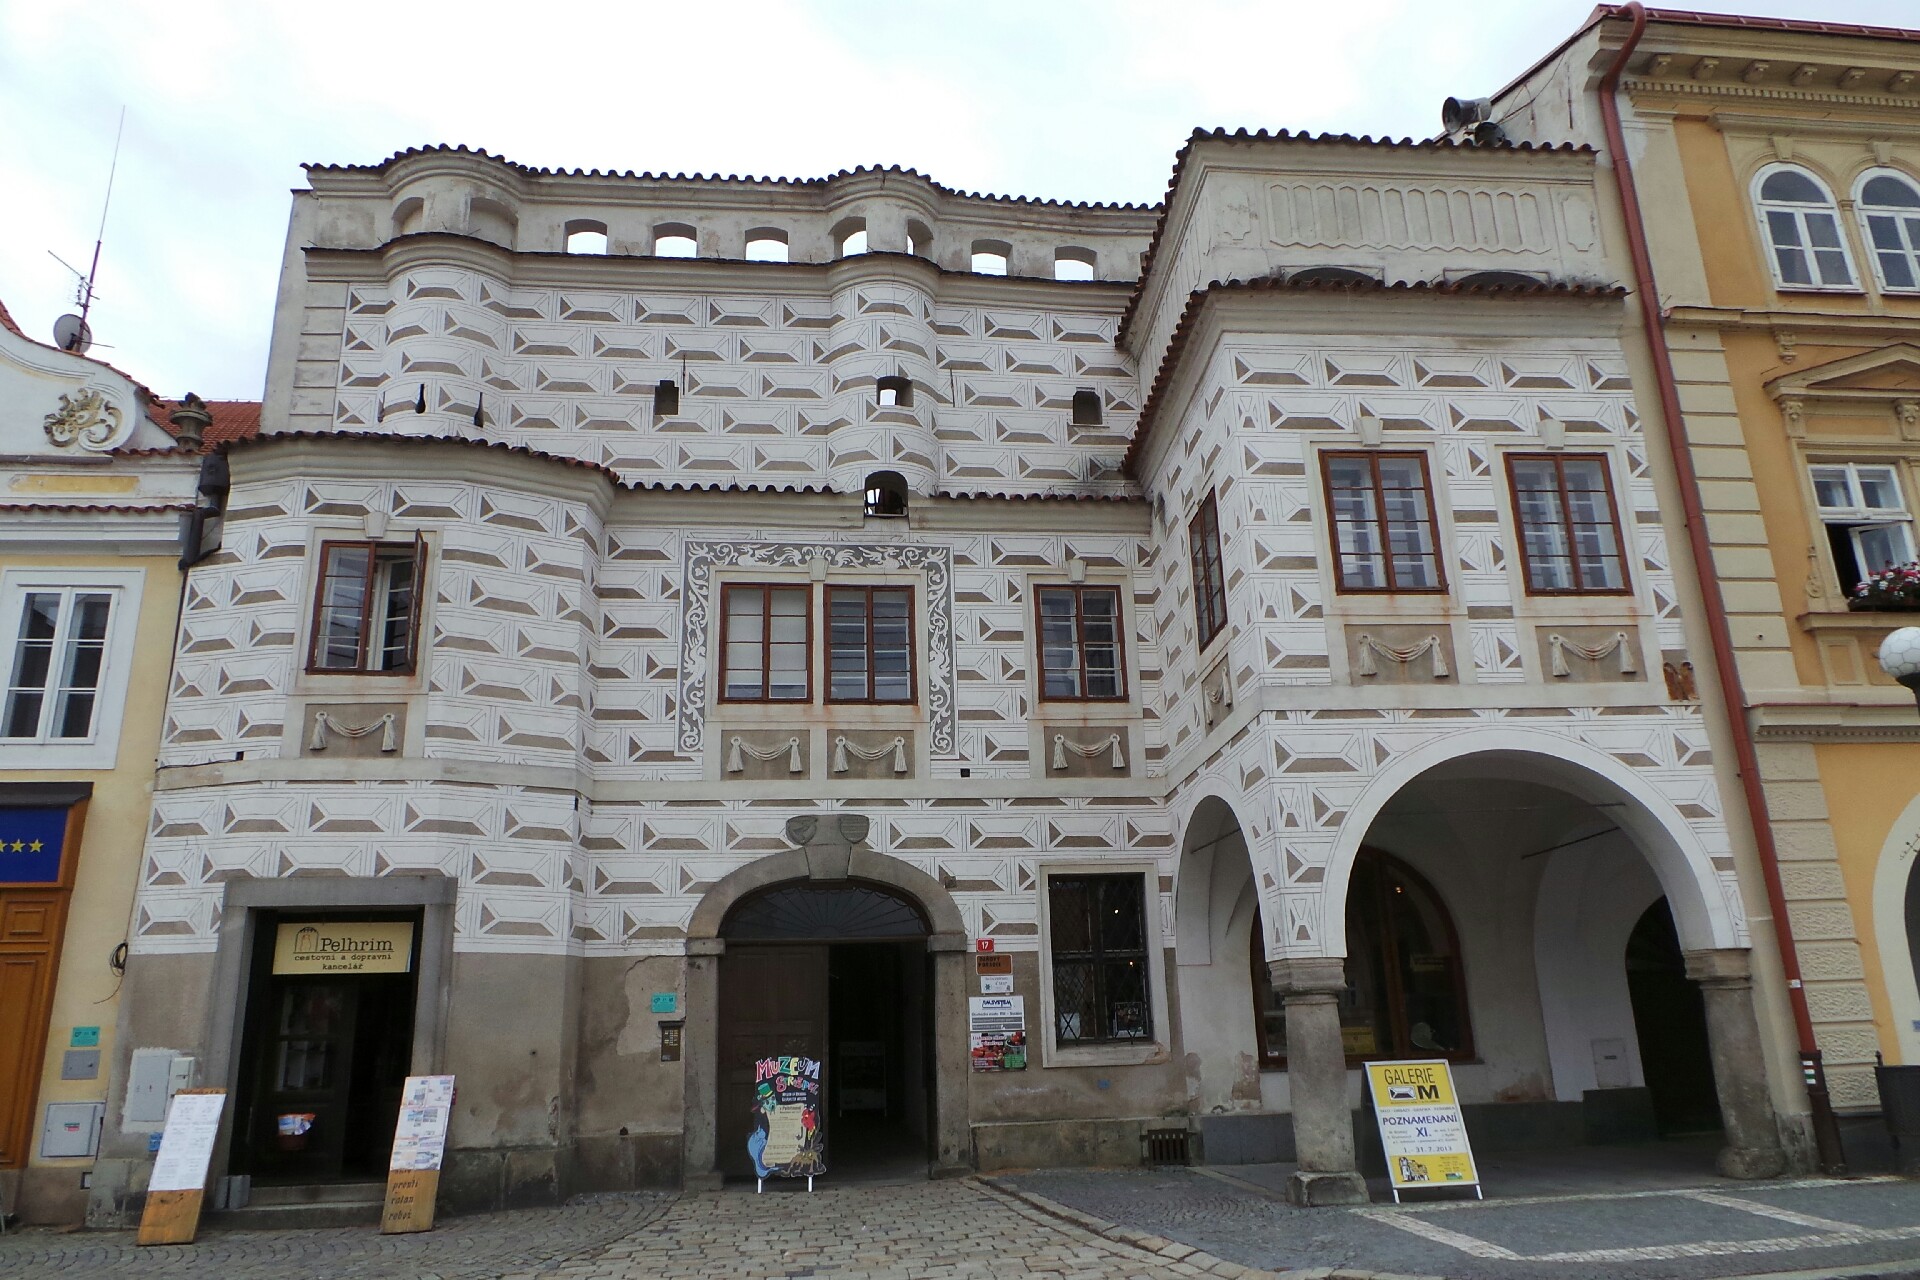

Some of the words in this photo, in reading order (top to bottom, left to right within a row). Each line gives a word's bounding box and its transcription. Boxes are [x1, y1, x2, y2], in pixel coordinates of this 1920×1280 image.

[320, 938, 393, 952] Pelhrim
[981, 941, 989, 950] 17
[755, 1056, 820, 1082] MUZEUM
[1384, 1067, 1435, 1085] GALERIE
[1417, 1085, 1440, 1100] M
[1382, 1112, 1458, 1126] POZNAMENANÍ
[1415, 1127, 1432, 1138] XI.
